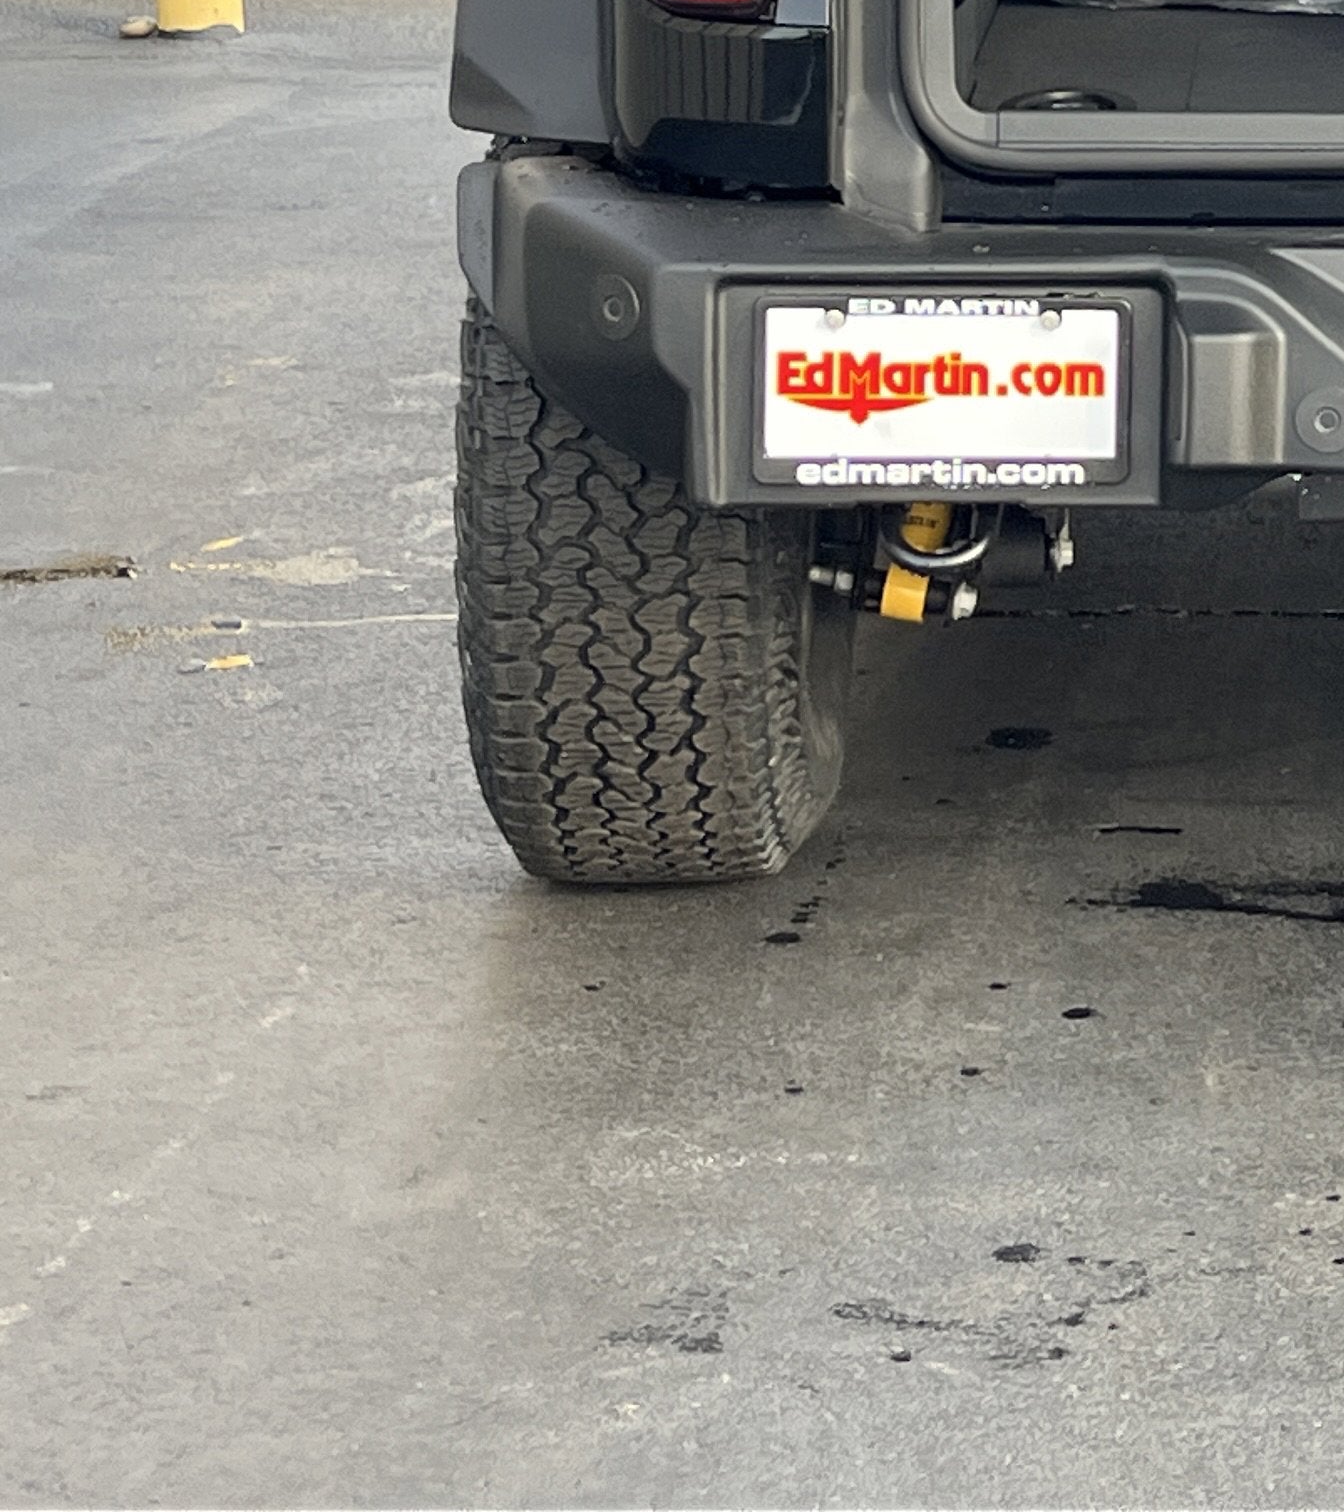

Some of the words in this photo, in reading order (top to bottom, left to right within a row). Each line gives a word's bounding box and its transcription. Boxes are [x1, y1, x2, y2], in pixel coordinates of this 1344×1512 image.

[848, 299, 893, 316] ED
[904, 299, 1039, 316] MARTIN
[776, 351, 1105, 400] EdMartin.com
[796, 458, 1085, 486] edmartin.com
